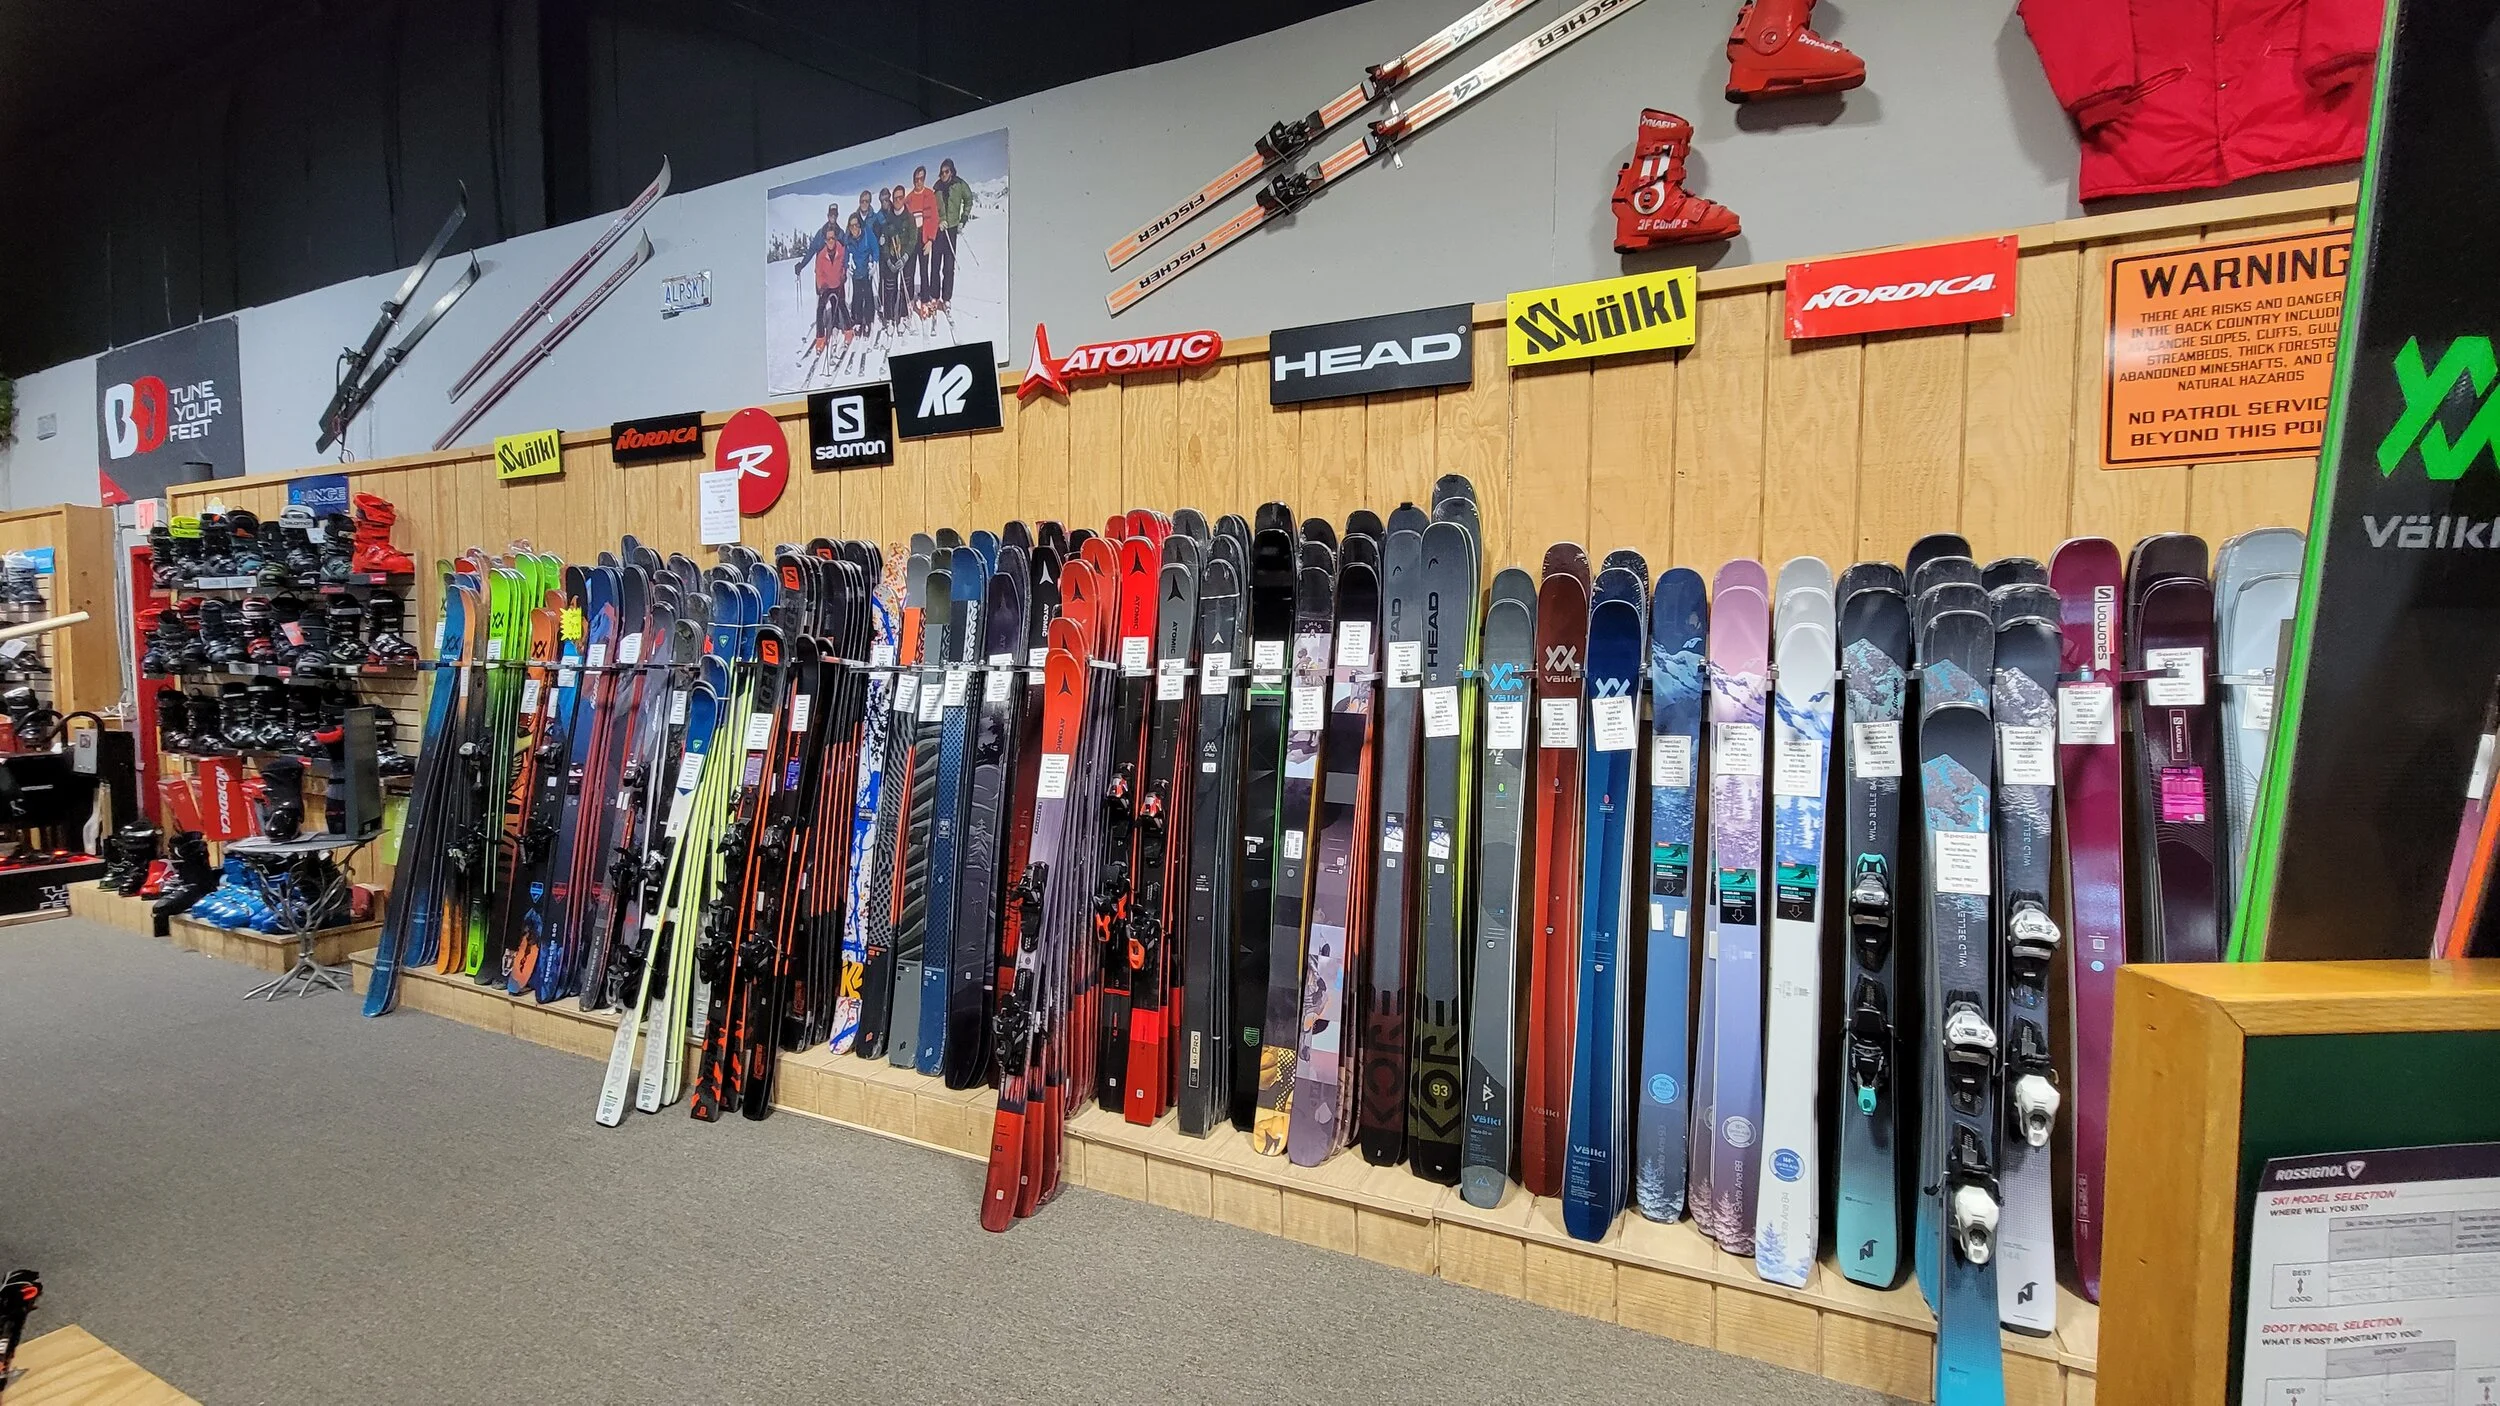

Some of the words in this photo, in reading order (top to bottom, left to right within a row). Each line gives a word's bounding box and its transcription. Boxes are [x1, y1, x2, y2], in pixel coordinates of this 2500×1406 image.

[1799, 33, 1841, 54] DYNAFIT
[1641, 115, 1678, 129] DYNAFIT
[1138, 194, 1206, 243] FISCHER
[1139, 242, 1207, 289] FISCHER
[665, 278, 706, 304] ALPSKI
[1801, 273, 1996, 311] NORDICA
[2140, 309, 2179, 323] THERE
[2182, 306, 2207, 319] ARE
[2212, 301, 2251, 316] RISKS
[2256, 297, 2282, 311] AND
[2287, 291, 2342, 308] DANGER
[2131, 327, 2144, 340] IN
[2146, 325, 2171, 338] THE
[2175, 319, 2213, 334] BACK
[2216, 313, 2281, 331] COUNTRY
[2285, 306, 2340, 323] INCLUDI
[2308, 322, 2338, 335] GULL
[1060, 333, 1213, 377] ATOMIC
[1274, 332, 1464, 382] HEAD
[2239, 341, 2275, 356] THICK
[2278, 337, 2336, 353] FORESTS
[2119, 365, 2196, 383] ABANDONED
[2293, 353, 2322, 366] AND
[2177, 377, 2236, 391] NATURAL
[2239, 370, 2305, 387] HAZARDS
[169, 380, 214, 405] TUNE
[916, 364, 974, 418] K2
[174, 398, 223, 422] YOUR
[2128, 411, 2155, 425] NO
[2162, 404, 2242, 423] PATROL
[2247, 396, 2329, 416] SERVIC
[169, 419, 213, 442] FEET
[615, 427, 697, 451] NORDICA
[2130, 428, 2219, 447] BEYOND
[2225, 423, 2276, 440] THIS
[2284, 419, 2322, 435] POI
[727, 444, 773, 480] R
[815, 440, 887, 461] salomon
[1041, 603, 1049, 638] ATOMIC
[1132, 595, 1140, 630] ATOMIC
[1170, 620, 1178, 655] ATOMIC
[1427, 591, 1439, 668] HEAD
[2098, 603, 2108, 660] salomon
[1545, 674, 1577, 683] Völkl
[1055, 718, 1065, 752] ATOMIC
[215, 765, 232, 834] NORDICA
[1958, 943, 1967, 969] WILD
[840, 960, 864, 1000] K2
[1432, 1083, 1449, 1097] 93
[1471, 1114, 1502, 1126] Völkl
[1531, 1105, 1560, 1118] Völkl
[1573, 1144, 1606, 1158] Völkl
[1735, 1171, 1743, 1189] Ana
[2275, 1165, 2346, 1181] ROSSIGNOL
[1734, 1189, 1743, 1213] Santa
[2271, 1196, 2290, 1206] SKI
[2291, 1193, 2330, 1205] MODEL
[2333, 1189, 2397, 1202] SELECTION
[2270, 1208, 2302, 1217] WHERE
[2305, 1206, 2326, 1215] WILL
[2329, 1205, 2347, 1213] YOU
[2292, 1269, 2312, 1277] BEST
[2262, 1324, 2296, 1334] BOOT
[2298, 1322, 2339, 1333] MODEL
[2343, 1317, 2404, 1330] SELECTION
[2261, 1338, 2290, 1346] WHAT
[2292, 1337, 2301, 1345] IS
[2304, 1337, 2331, 1345] MOST
[2334, 1333, 2382, 1344] IMPORTANT
[2384, 1331, 2397, 1339] TO
